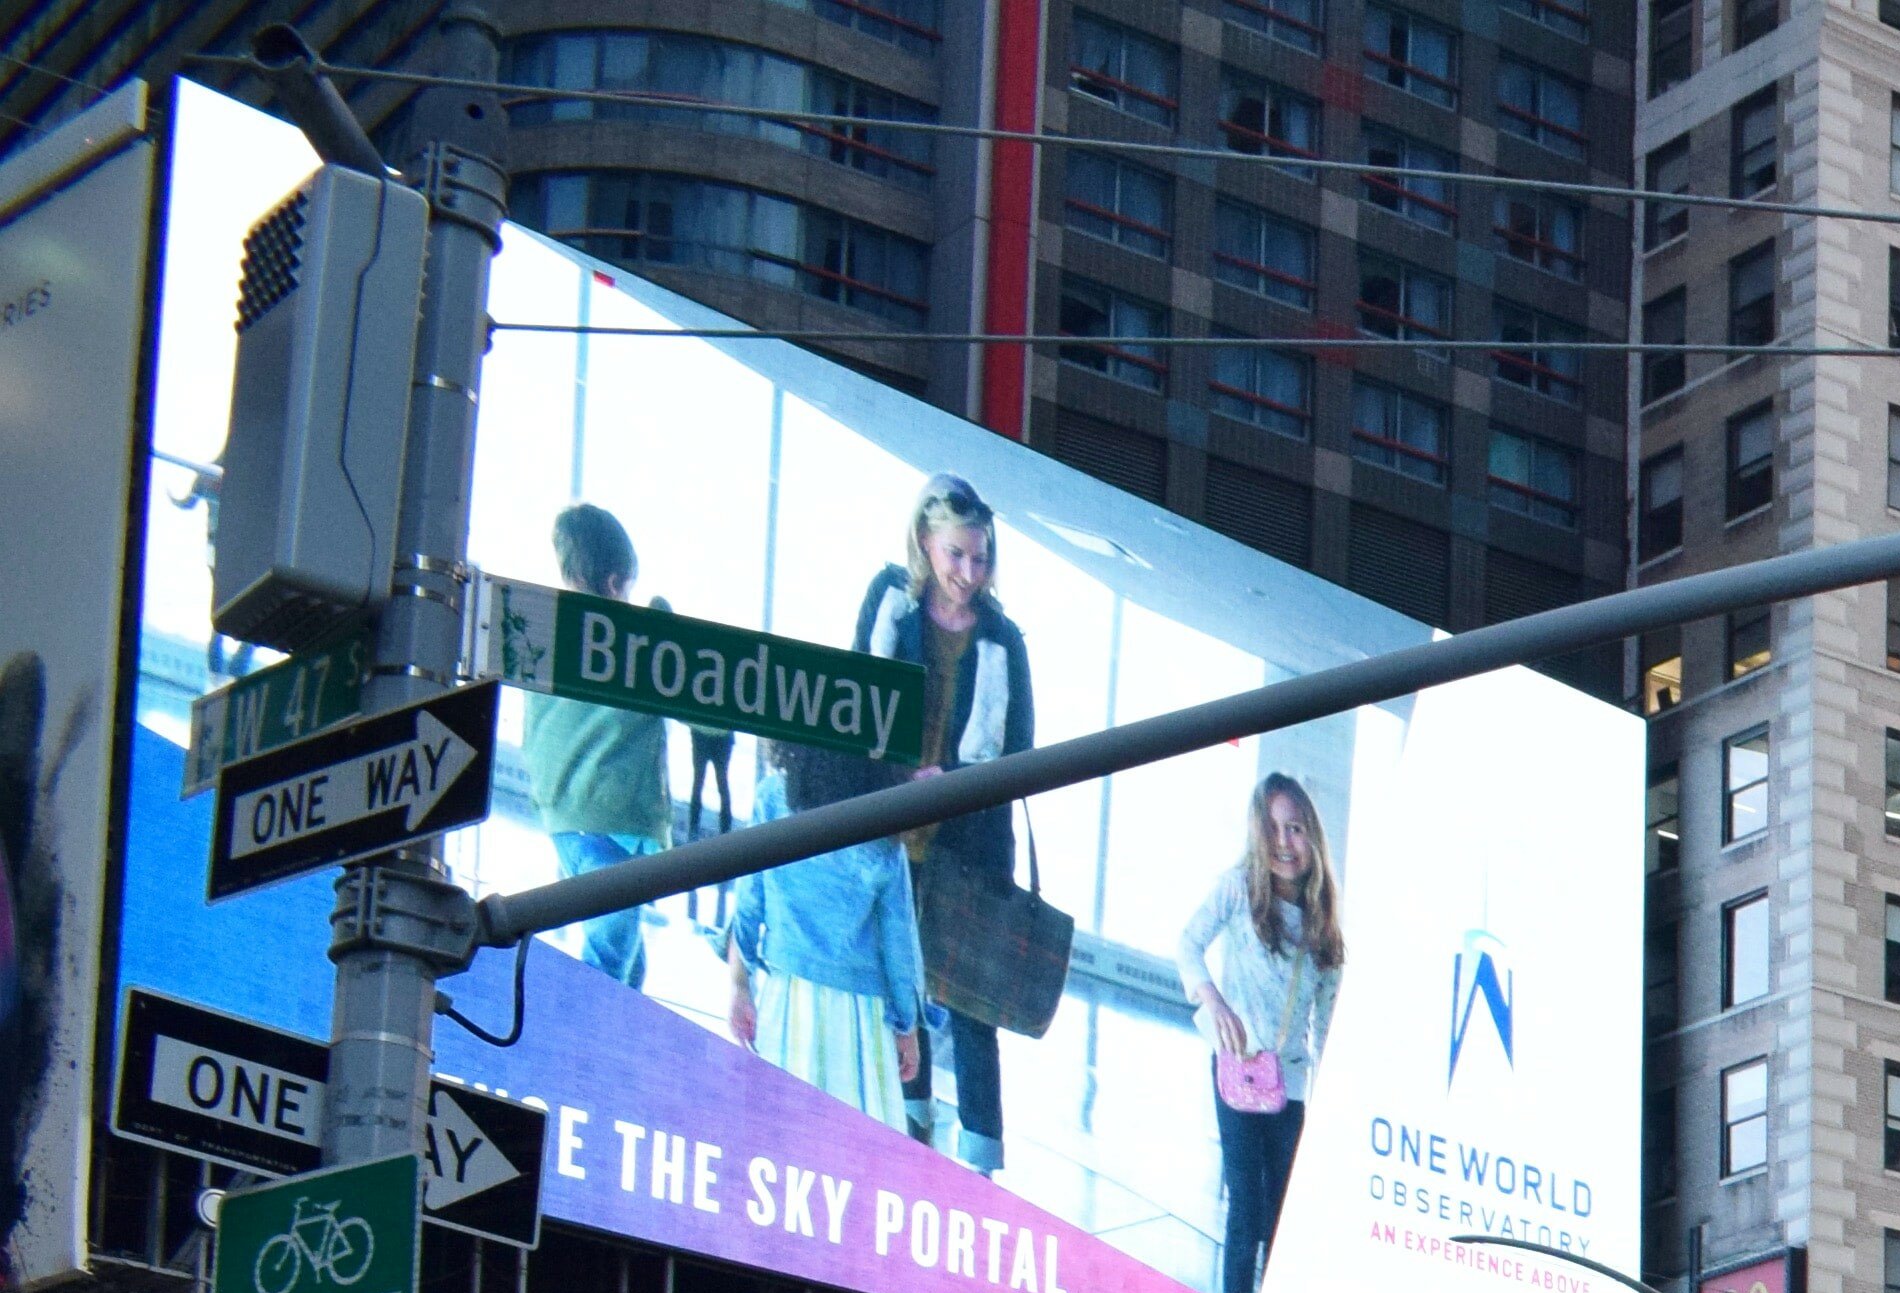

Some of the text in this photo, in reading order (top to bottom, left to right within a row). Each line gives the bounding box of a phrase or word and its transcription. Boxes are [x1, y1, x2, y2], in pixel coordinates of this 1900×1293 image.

[236, 655, 330, 757] W 47
[581, 612, 902, 760] Broadway
[253, 737, 450, 845] ONE WAY
[187, 1055, 308, 1136] ONE
[614, 1121, 721, 1214] THE
[746, 1155, 853, 1246] SKY
[1370, 1174, 1590, 1259] OBSERVATORY
[1371, 1117, 1592, 1218] ONE WORLD
[1370, 1221, 1396, 1245] AN
[1404, 1230, 1523, 1281] EXPERIENCE
